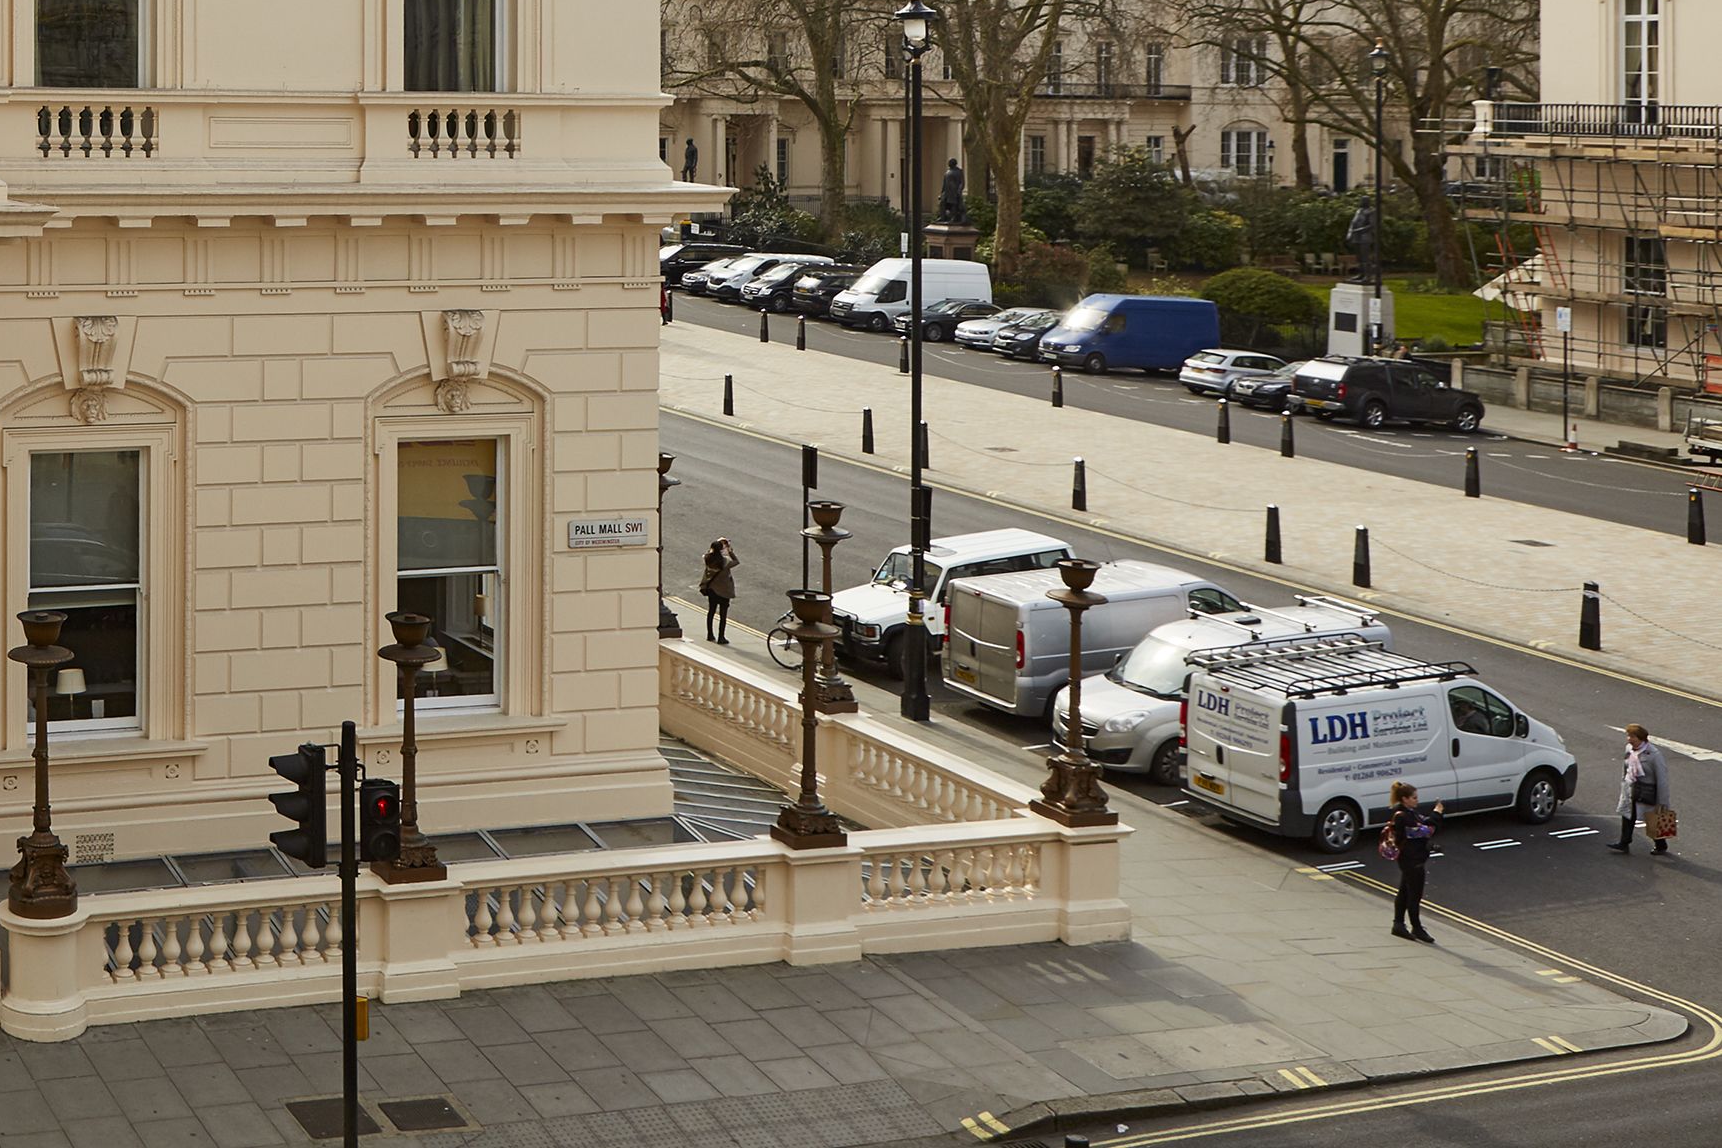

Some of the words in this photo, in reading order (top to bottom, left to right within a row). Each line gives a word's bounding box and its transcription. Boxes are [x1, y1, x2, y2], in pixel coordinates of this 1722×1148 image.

[575, 525, 596, 535] PALL
[599, 524, 622, 534] MALL
[625, 523, 642, 532] SW1
[1198, 690, 1230, 716] LDH
[1372, 706, 1426, 725] Project
[1309, 711, 1370, 744] LDH
